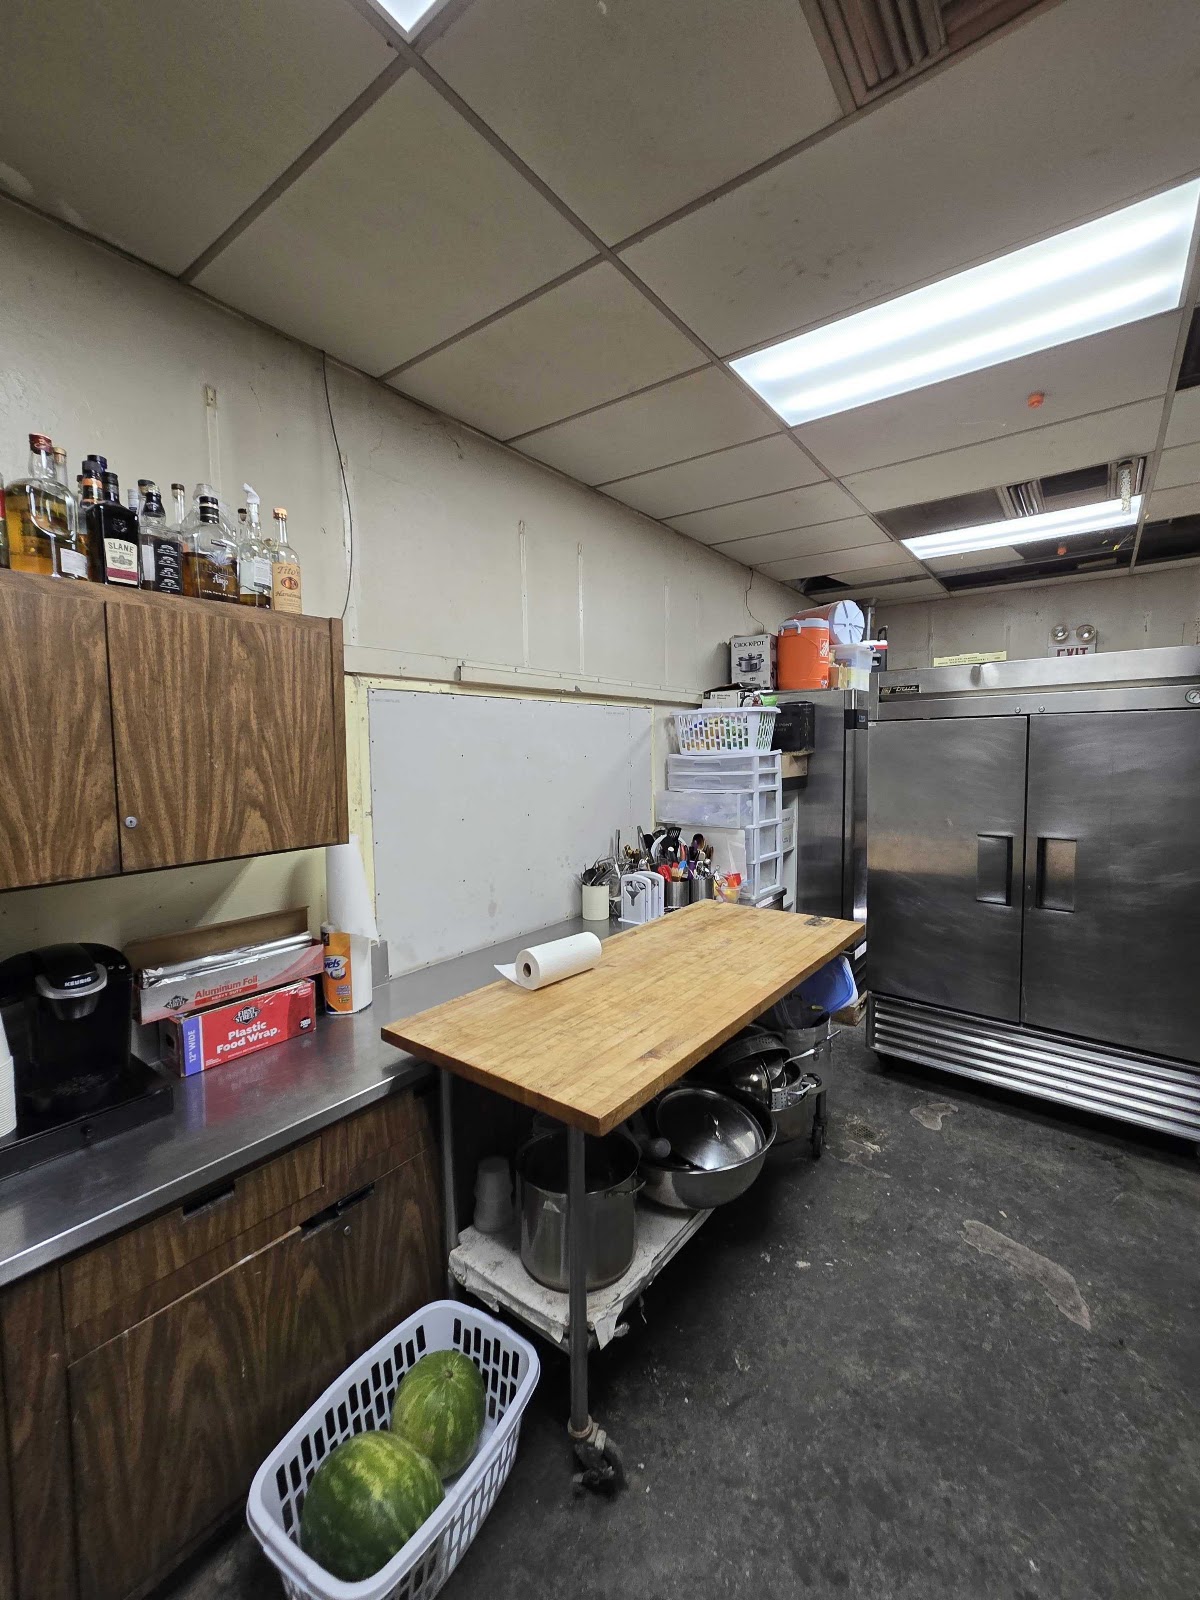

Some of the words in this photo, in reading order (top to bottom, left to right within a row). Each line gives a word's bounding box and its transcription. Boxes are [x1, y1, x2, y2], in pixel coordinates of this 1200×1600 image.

[107, 541, 134, 554] SLANE
[64, 977, 92, 987] KEURIG
[194, 979, 242, 999] Aluminum
[243, 975, 258, 987] Foil
[235, 1010, 258, 1023] STREET
[238, 1006, 255, 1017] FIRST
[227, 1020, 267, 1041] Plastic
[187, 1029, 196, 1051] WIDE
[216, 1038, 246, 1054] Food
